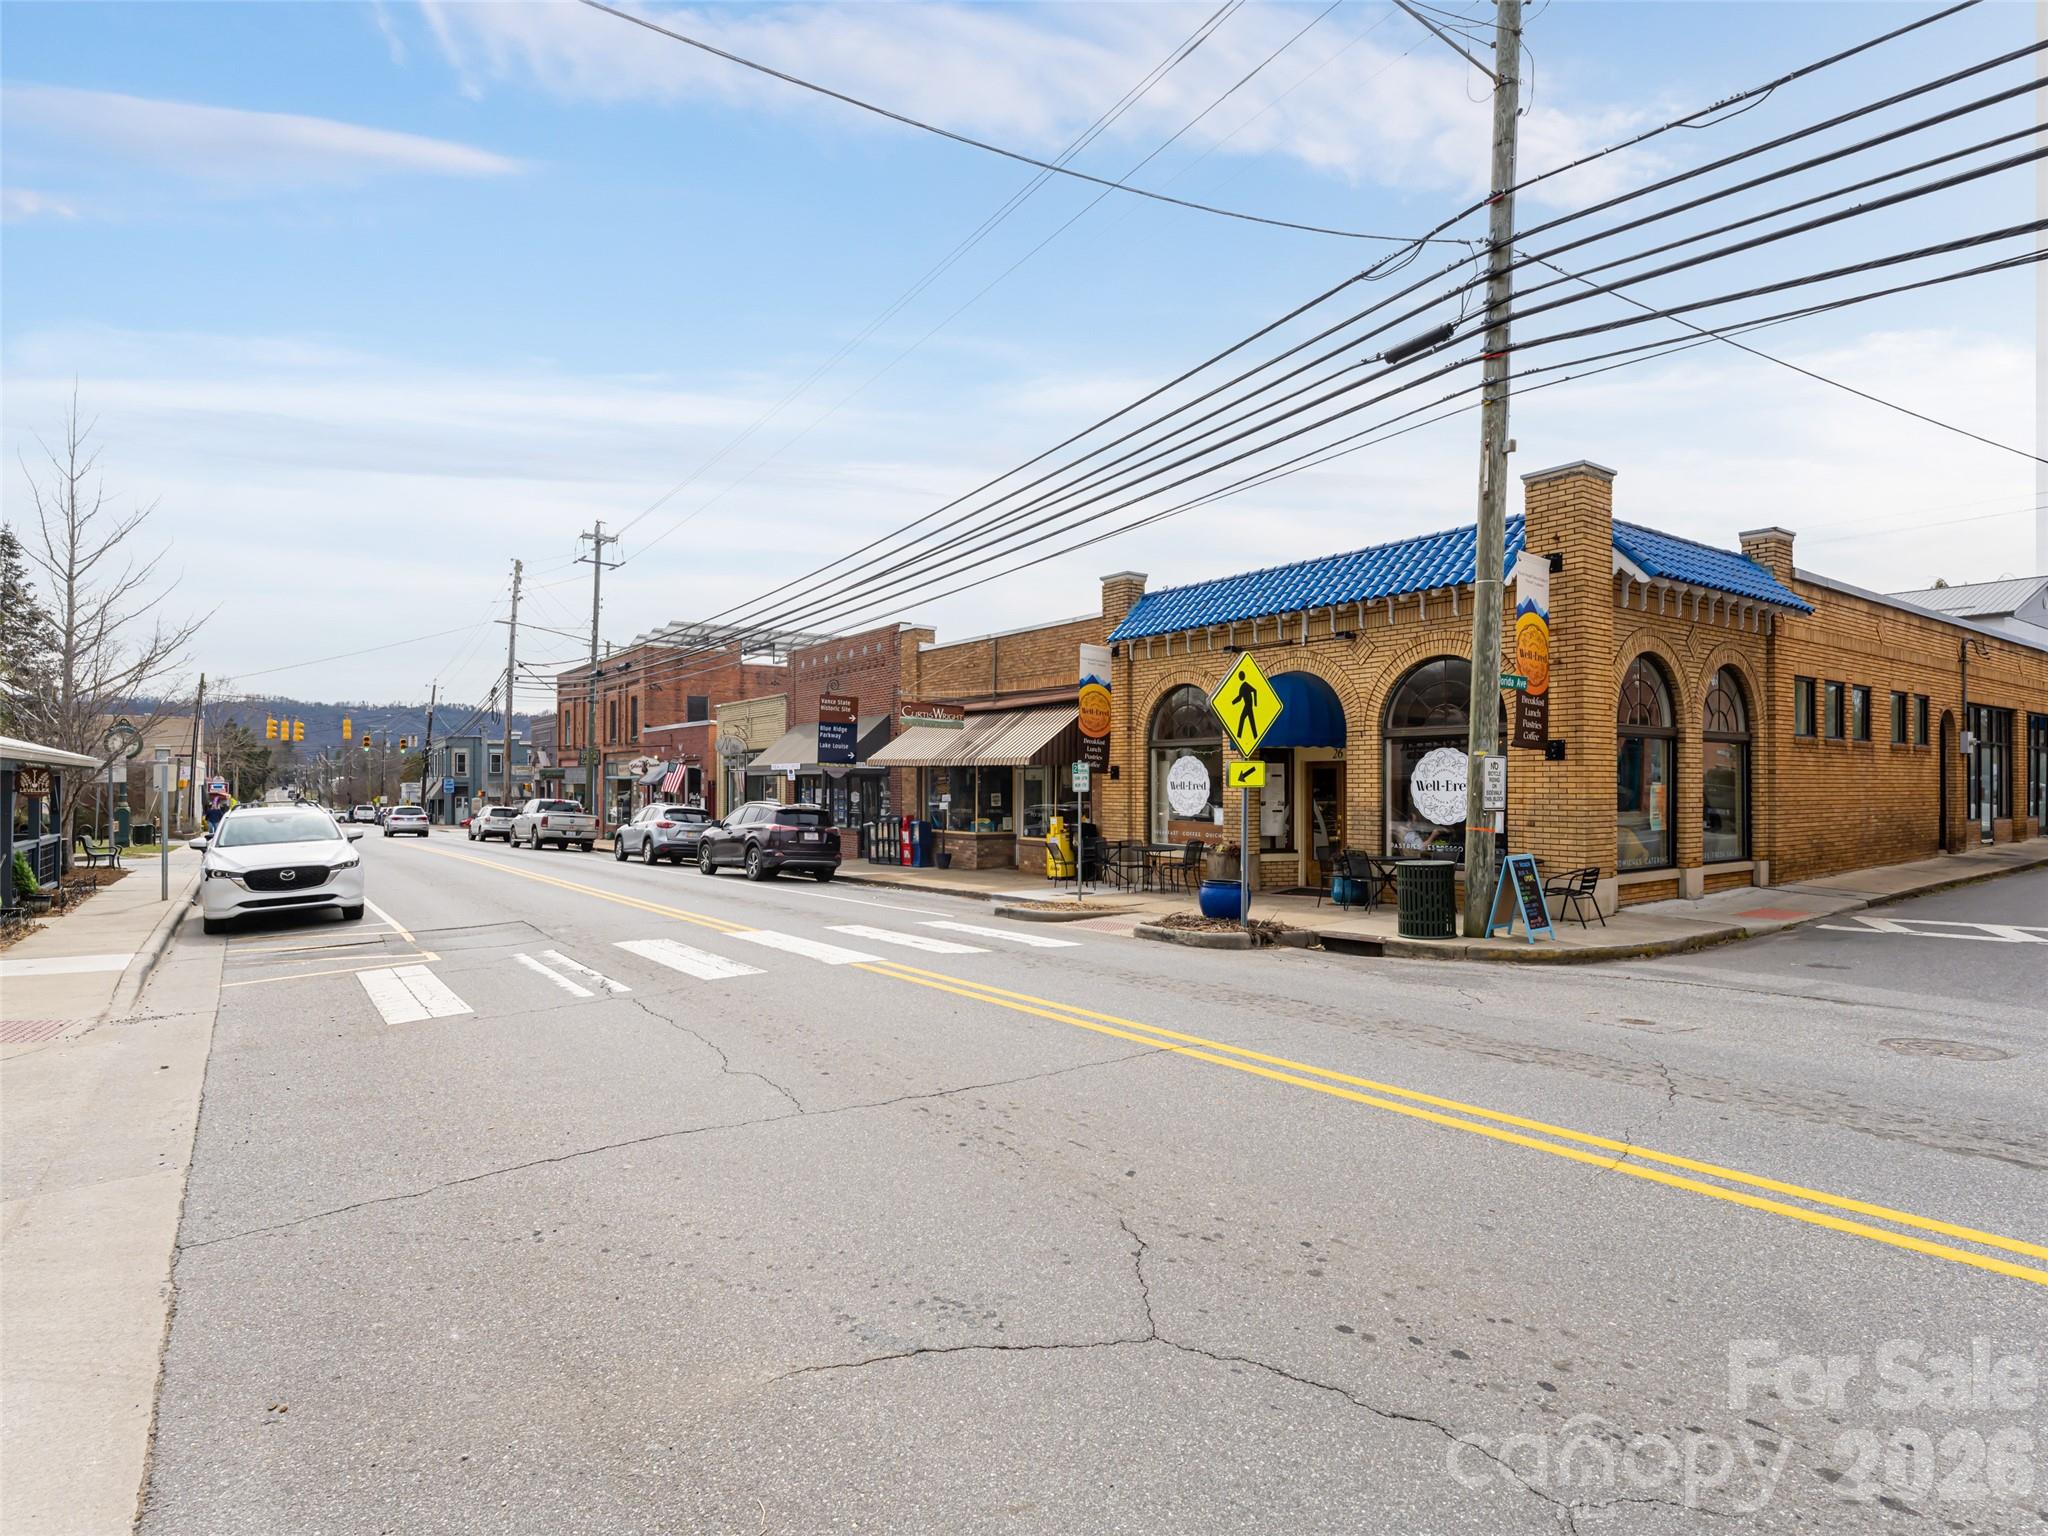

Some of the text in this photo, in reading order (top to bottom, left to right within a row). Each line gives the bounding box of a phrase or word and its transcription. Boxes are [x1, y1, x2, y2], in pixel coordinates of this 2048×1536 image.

[1500, 676, 1527, 688] orida Ave
[1521, 696, 1545, 706] Breakfast
[1524, 707, 1541, 717] Lunch
[1522, 719, 1542, 729] Pastries
[833, 726, 848, 734] Ridge
[819, 732, 842, 740] Parkway
[1523, 731, 1540, 741] Coffee
[1086, 745, 1102, 753] Lunch
[1333, 748, 1343, 759] 26
[1088, 760, 1101, 768] offee
[1490, 761, 1499, 770] NO
[1170, 781, 1207, 791] Well-Bred
[1416, 780, 1467, 792] Well-Bre
